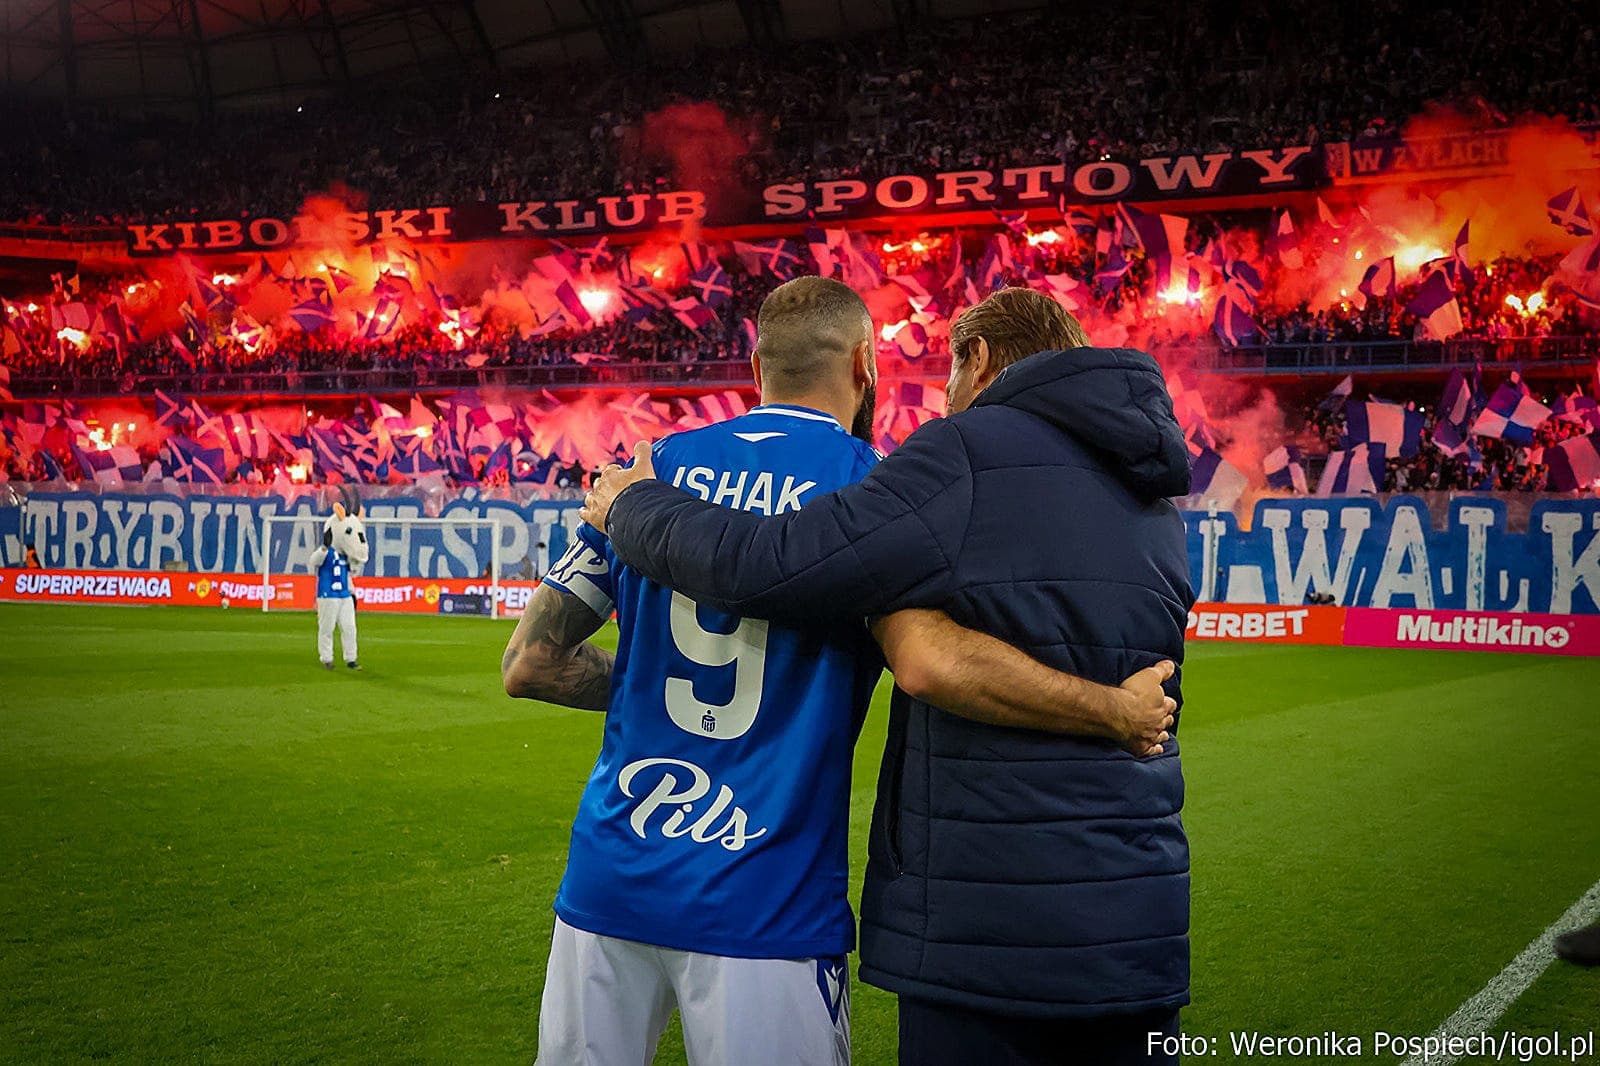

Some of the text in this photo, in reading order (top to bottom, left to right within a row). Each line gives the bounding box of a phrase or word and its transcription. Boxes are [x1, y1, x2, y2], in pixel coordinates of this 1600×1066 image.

[127, 146, 1312, 251] KIBOSKI KLUB SPORTOWY
[671, 465, 818, 517] ISHAK
[26, 499, 420, 578] TRYBUNAH
[15, 573, 172, 598] SUPERPRZEWAGA
[664, 590, 770, 740] 9
[1397, 614, 1570, 648] Multikino
[618, 757, 768, 851] Pils
